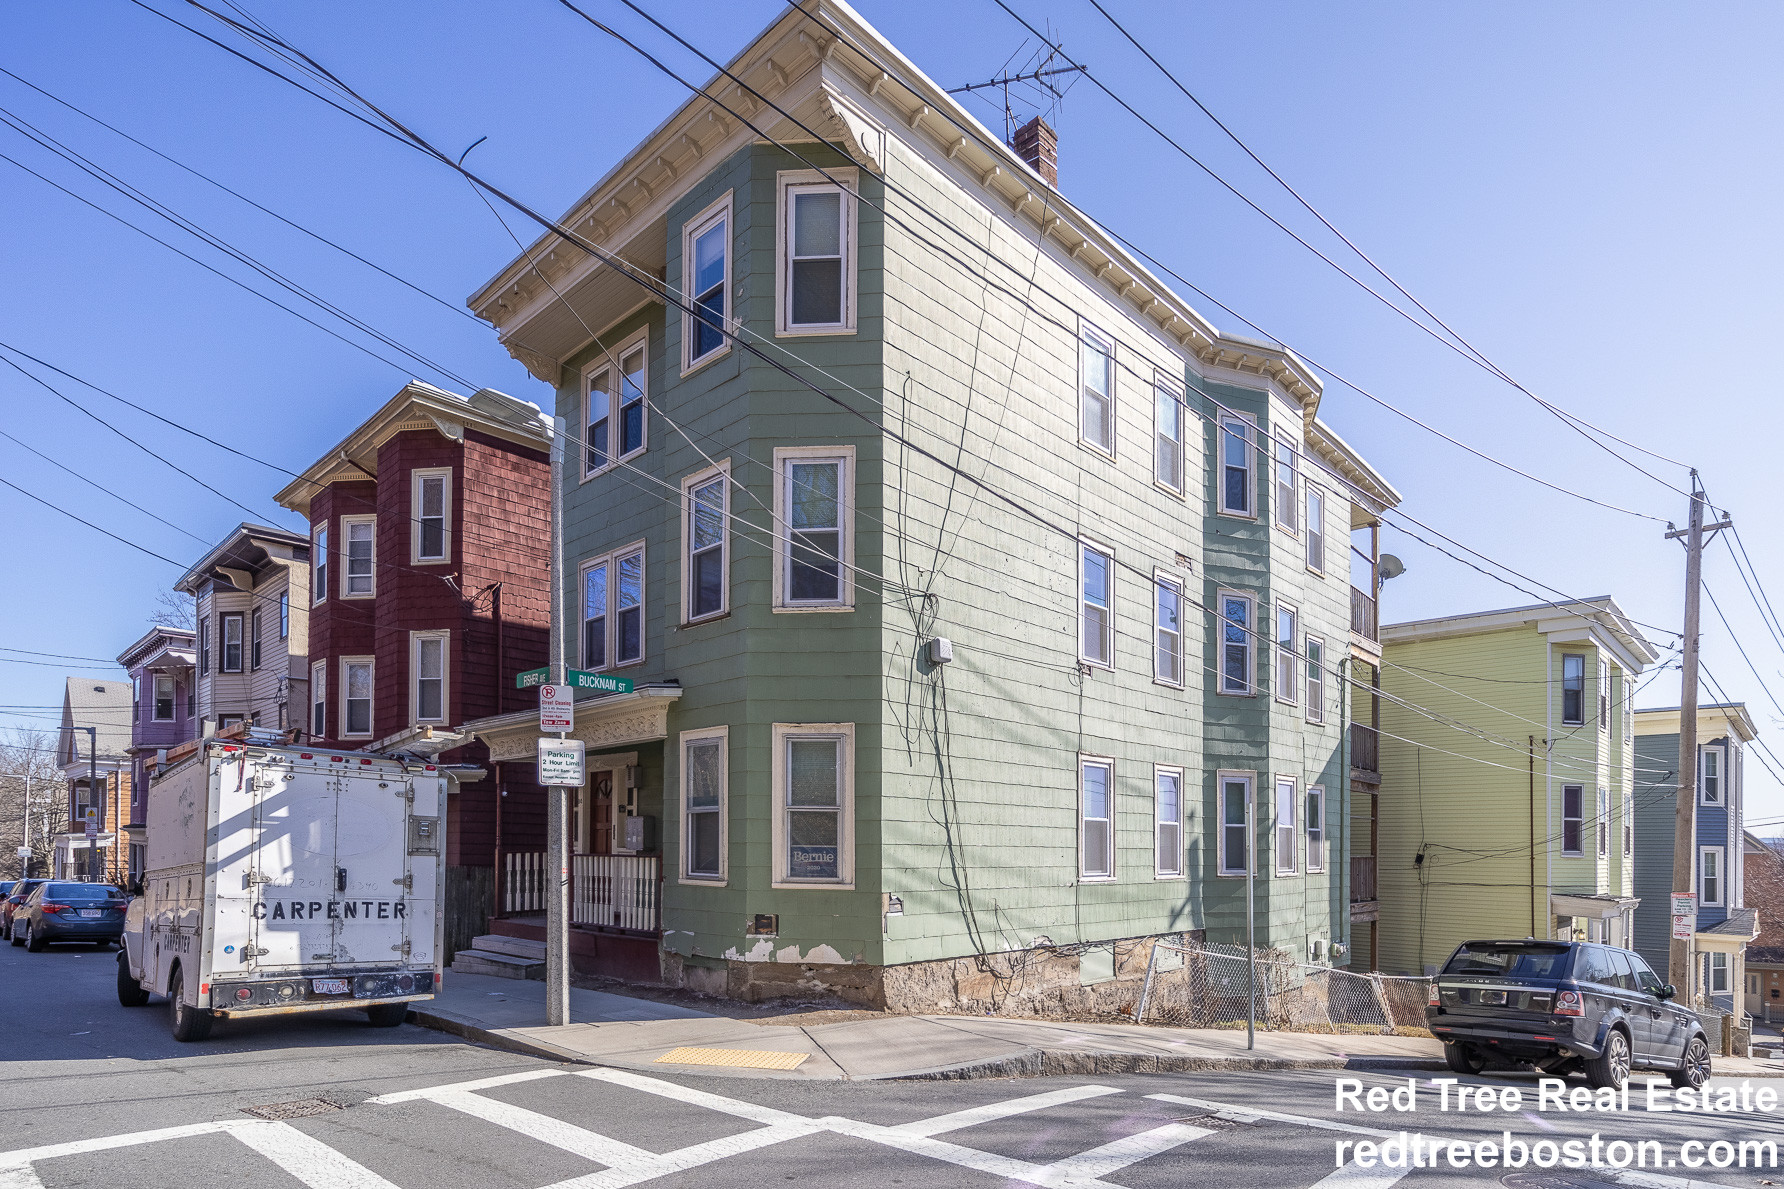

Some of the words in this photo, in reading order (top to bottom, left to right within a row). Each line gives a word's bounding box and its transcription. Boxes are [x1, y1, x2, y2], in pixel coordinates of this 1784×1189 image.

[523, 673, 539, 687] FISHER
[578, 674, 616, 691] BUCKNAM
[618, 682, 626, 692] ST
[547, 750, 575, 760] Parking
[793, 851, 835, 863] Bernie
[253, 901, 406, 920] CARPENTER
[164, 933, 191, 954] CARPENTER
